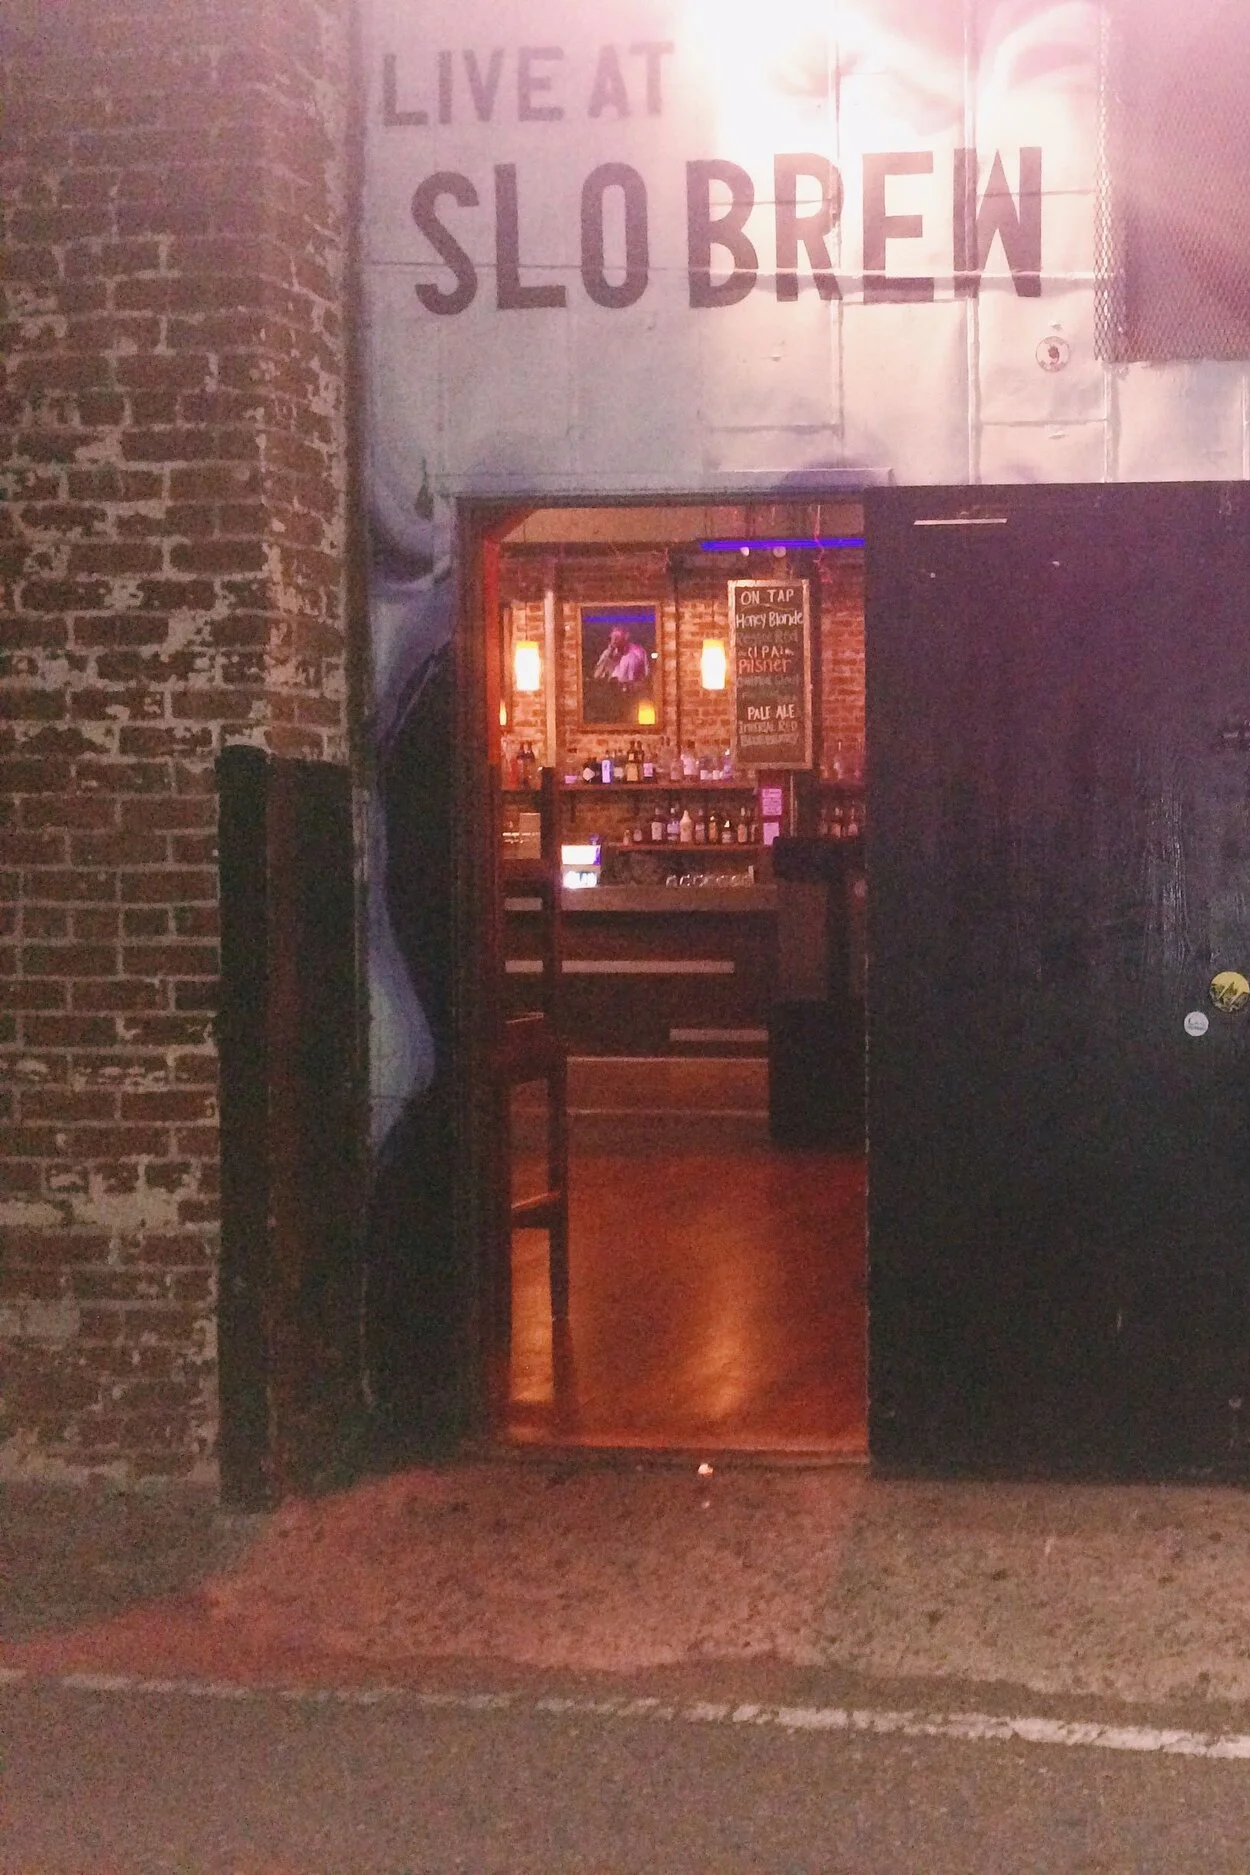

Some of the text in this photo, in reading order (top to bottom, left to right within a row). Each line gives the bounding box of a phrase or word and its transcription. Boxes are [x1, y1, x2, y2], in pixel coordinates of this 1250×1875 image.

[380, 40, 675, 127] LIVE AT
[409, 146, 1043, 316] SLO BREW
[740, 588, 795, 605] ON TAP
[735, 609, 804, 629] Honey Blonde
[738, 658, 792, 674] Pilsner
[747, 703, 796, 721] PALE ALE
